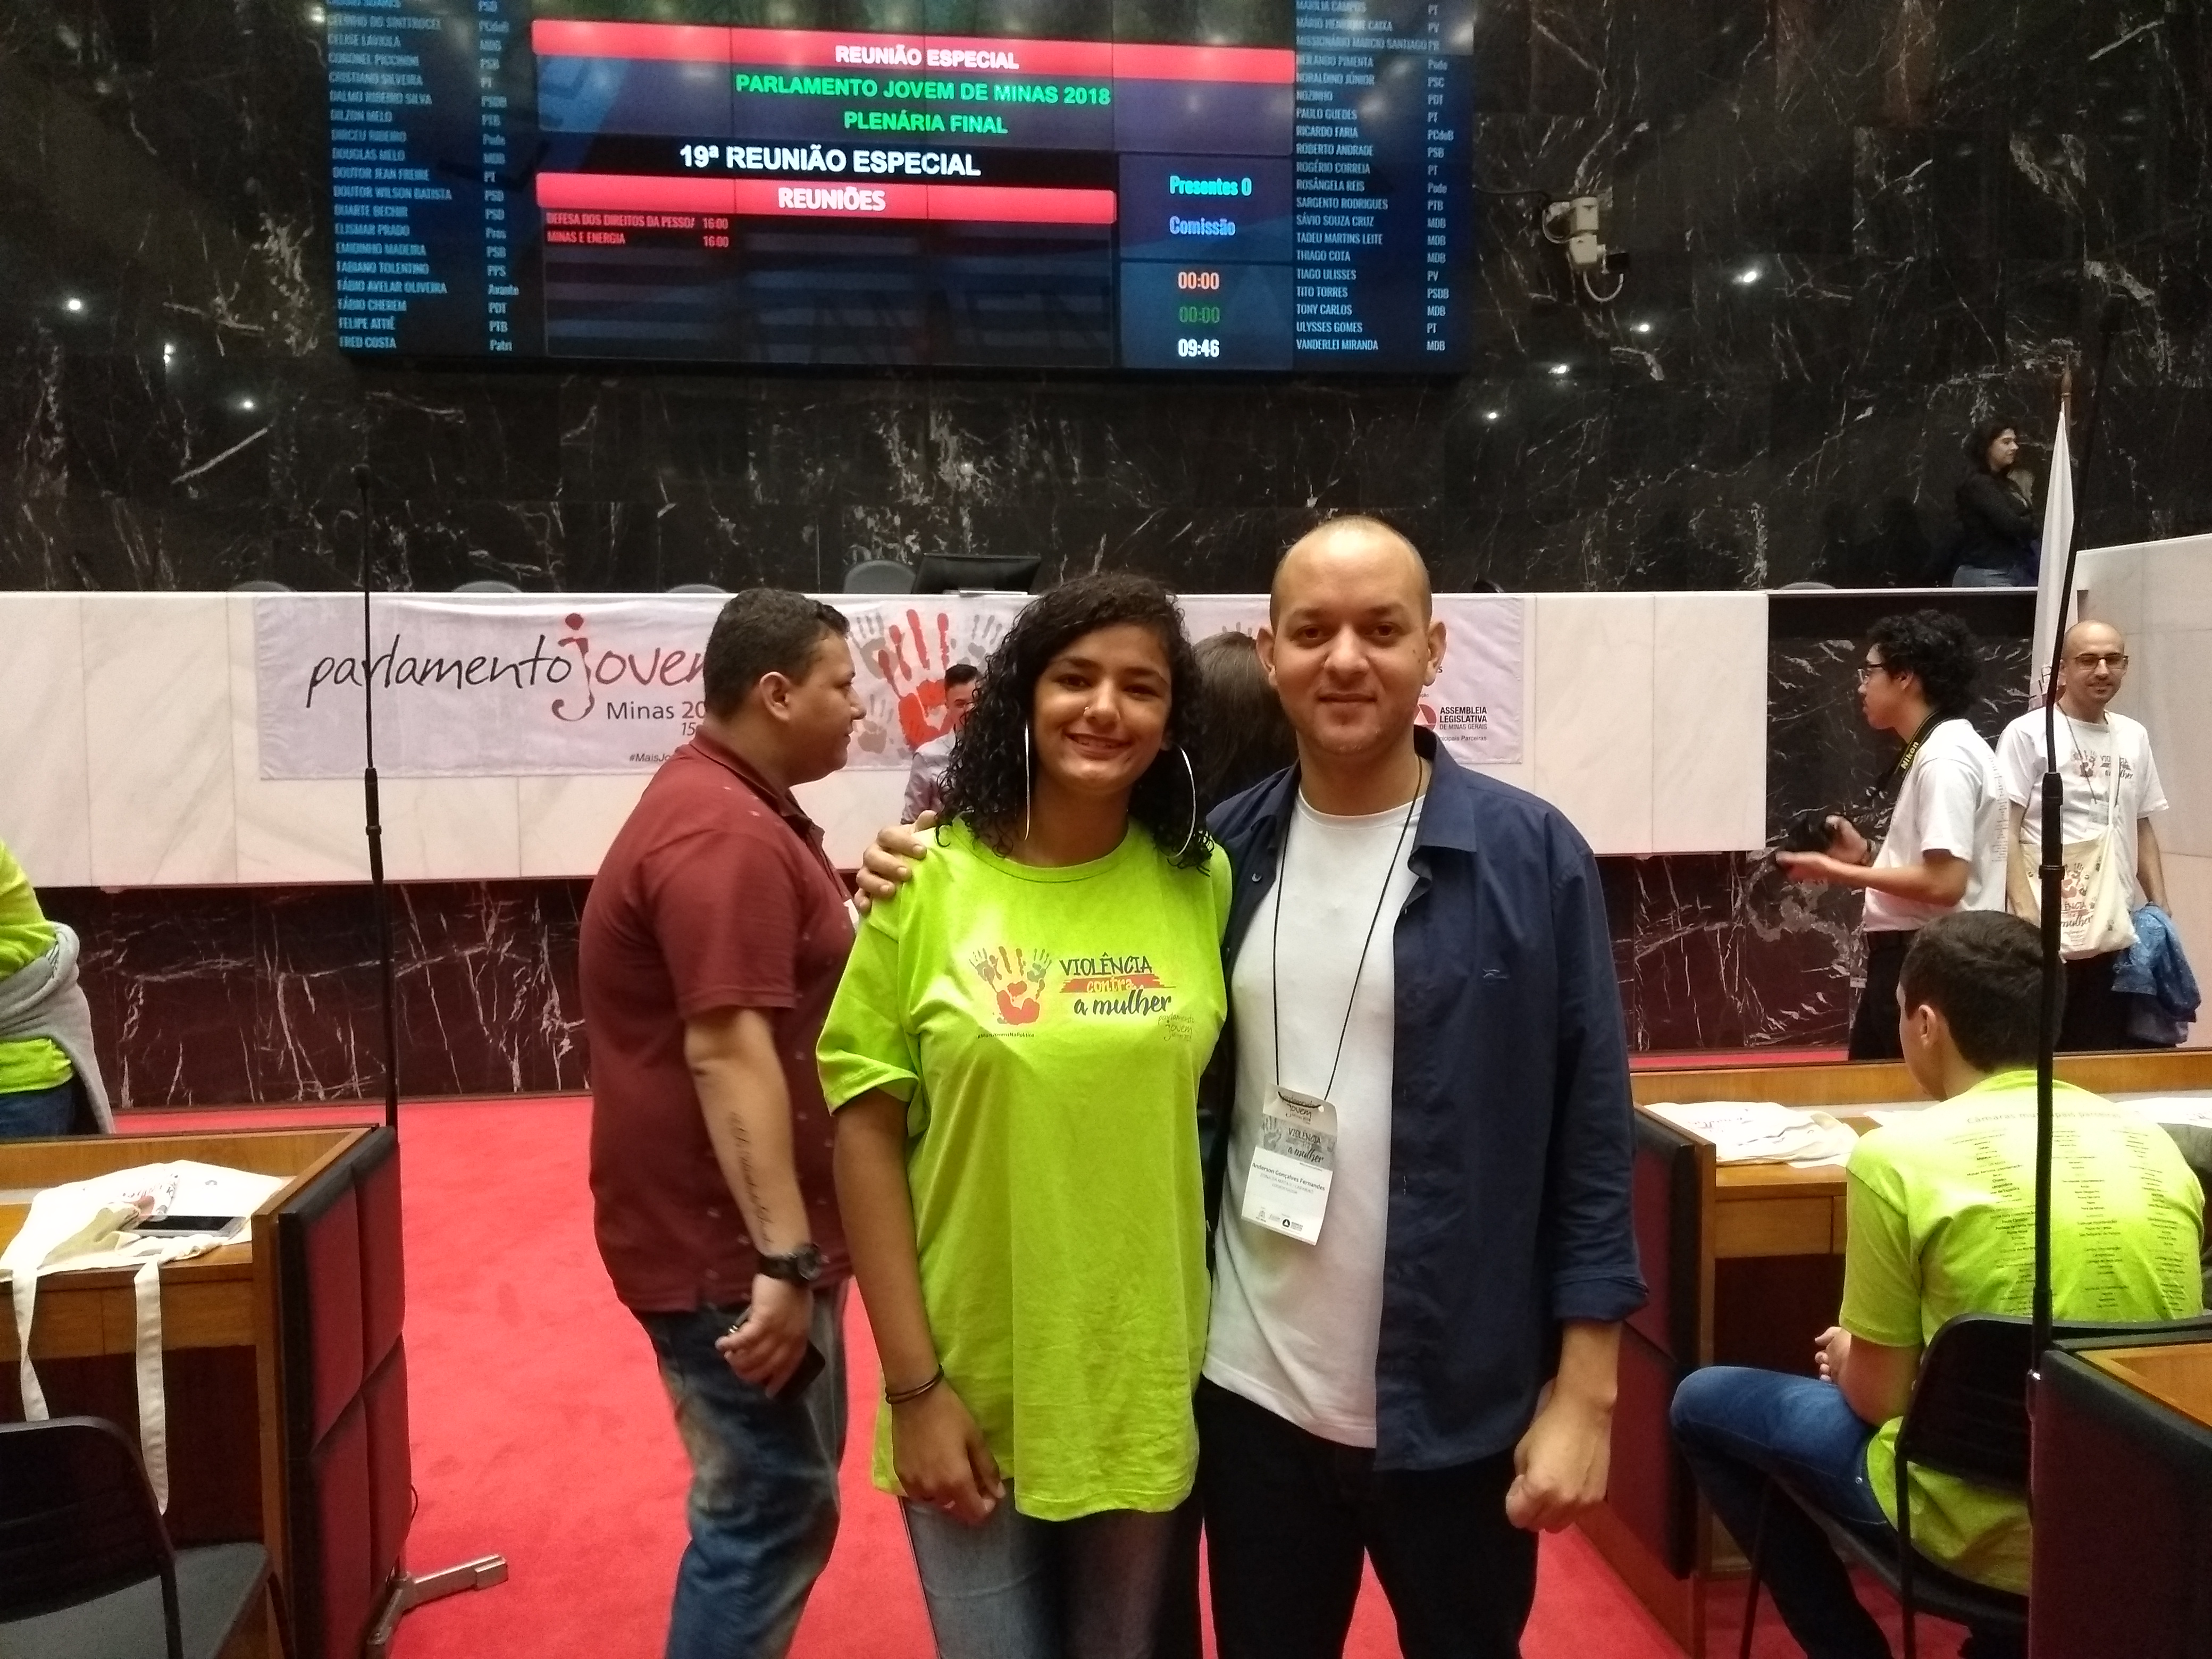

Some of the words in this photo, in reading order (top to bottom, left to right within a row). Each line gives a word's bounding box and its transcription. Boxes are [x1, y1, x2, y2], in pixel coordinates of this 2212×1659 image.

[835, 44, 922, 65] REUNIÃO
[927, 49, 1020, 69] ESPECIAL
[735, 73, 878, 97] PARLAMENTO
[883, 80, 954, 99] JOVEM
[960, 82, 988, 100] DE
[994, 84, 1059, 103] MINAS
[1063, 86, 1111, 105] 2018
[1428, 94, 1443, 105] PDT
[1296, 108, 1323, 119] PAULO
[1428, 112, 1438, 122] PT
[844, 109, 945, 131] PLENÁRIA
[950, 115, 1009, 133] FINAL
[1296, 125, 1333, 137] RICARDO
[1335, 127, 1359, 138] FARIA
[1296, 143, 1335, 155] ROBERTO
[1336, 144, 1373, 156] ANDRADE
[1427, 147, 1444, 158] PSB
[680, 144, 719, 169] 19ª
[726, 144, 847, 172] REUNIÃO
[853, 150, 982, 177] ESPECIAL
[1296, 159, 1333, 173] ROGÉRIO
[1428, 164, 1438, 175] PT
[1169, 175, 1239, 196] Presentes
[1241, 177, 1252, 197] 0
[1296, 177, 1345, 191] ROSÂNGELA
[1346, 180, 1365, 191] REIS
[778, 186, 886, 211] REUNIÕES
[1296, 197, 1339, 208] SARGENTO
[1340, 198, 1388, 210] RODRIGUES
[1427, 200, 1444, 211] PTB
[646, 215, 660, 228] DA
[702, 217, 729, 230] 16:00
[1169, 216, 1236, 236] Comissão
[1296, 212, 1321, 225] SÁVIO
[1323, 215, 1351, 227] SOUZA
[1352, 216, 1374, 227] CRUZ
[1427, 217, 1446, 229] MDB
[547, 230, 577, 244] MINAS
[579, 232, 585, 244] E
[586, 232, 626, 245] ENERGIA
[703, 236, 730, 248] 16:00
[1297, 232, 1322, 244] TADEU
[1324, 233, 1361, 244] MARTINS
[1362, 233, 1382, 245] LEITE
[1427, 235, 1446, 246] MDB
[1297, 250, 1327, 261] THIAGO
[1328, 250, 1351, 261] COTA
[1427, 252, 1446, 263] MDB
[1297, 268, 1321, 280] TIAGO
[1322, 269, 1356, 280] ULISSES
[1427, 270, 1439, 281] PV
[1178, 272, 1220, 290] 00:00
[1297, 286, 1314, 297] TITO
[1317, 287, 1348, 298] TORRES
[1427, 288, 1449, 299] PSDB
[488, 301, 506, 314] PDT
[1296, 304, 1318, 314] TONY
[1319, 304, 1352, 315] CARLOS
[1427, 305, 1446, 316] MDB
[1178, 306, 1221, 323] 00:00
[489, 321, 508, 332] PTB
[1296, 321, 1332, 332] ULYSSES
[1333, 322, 1363, 333] GOMES
[1427, 322, 1437, 333] PT
[365, 336, 396, 348] COSTA
[1178, 338, 1220, 357] 09:46
[1296, 339, 1340, 350] VANDERLEI
[1341, 339, 1378, 350] MIRANDA
[1427, 340, 1445, 351] MDB
[306, 634, 573, 709] parlamento
[607, 701, 674, 719] Minas
[1439, 715, 1487, 723] LEGISLATIVA
[1900, 741, 1919, 770] Nikon
[1059, 951, 1153, 976] VIOLÊNCIA
[1086, 975, 1136, 993] contra
[1074, 999, 1088, 1016] a
[1093, 988, 1172, 1017] mulher
[1158, 1011, 1195, 1025] parlamento
[1163, 1020, 1192, 1041] jovem
[1967, 1113, 2016, 1124] Câmaras
[1288, 1127, 1321, 1145] VIOLÊNCIA
[1294, 1147, 1325, 1163] mulher
[1251, 1162, 1275, 1174] Anderson
[1275, 1170, 1300, 1183] Gonçalves
[1300, 1178, 1326, 1192] Fernandes
